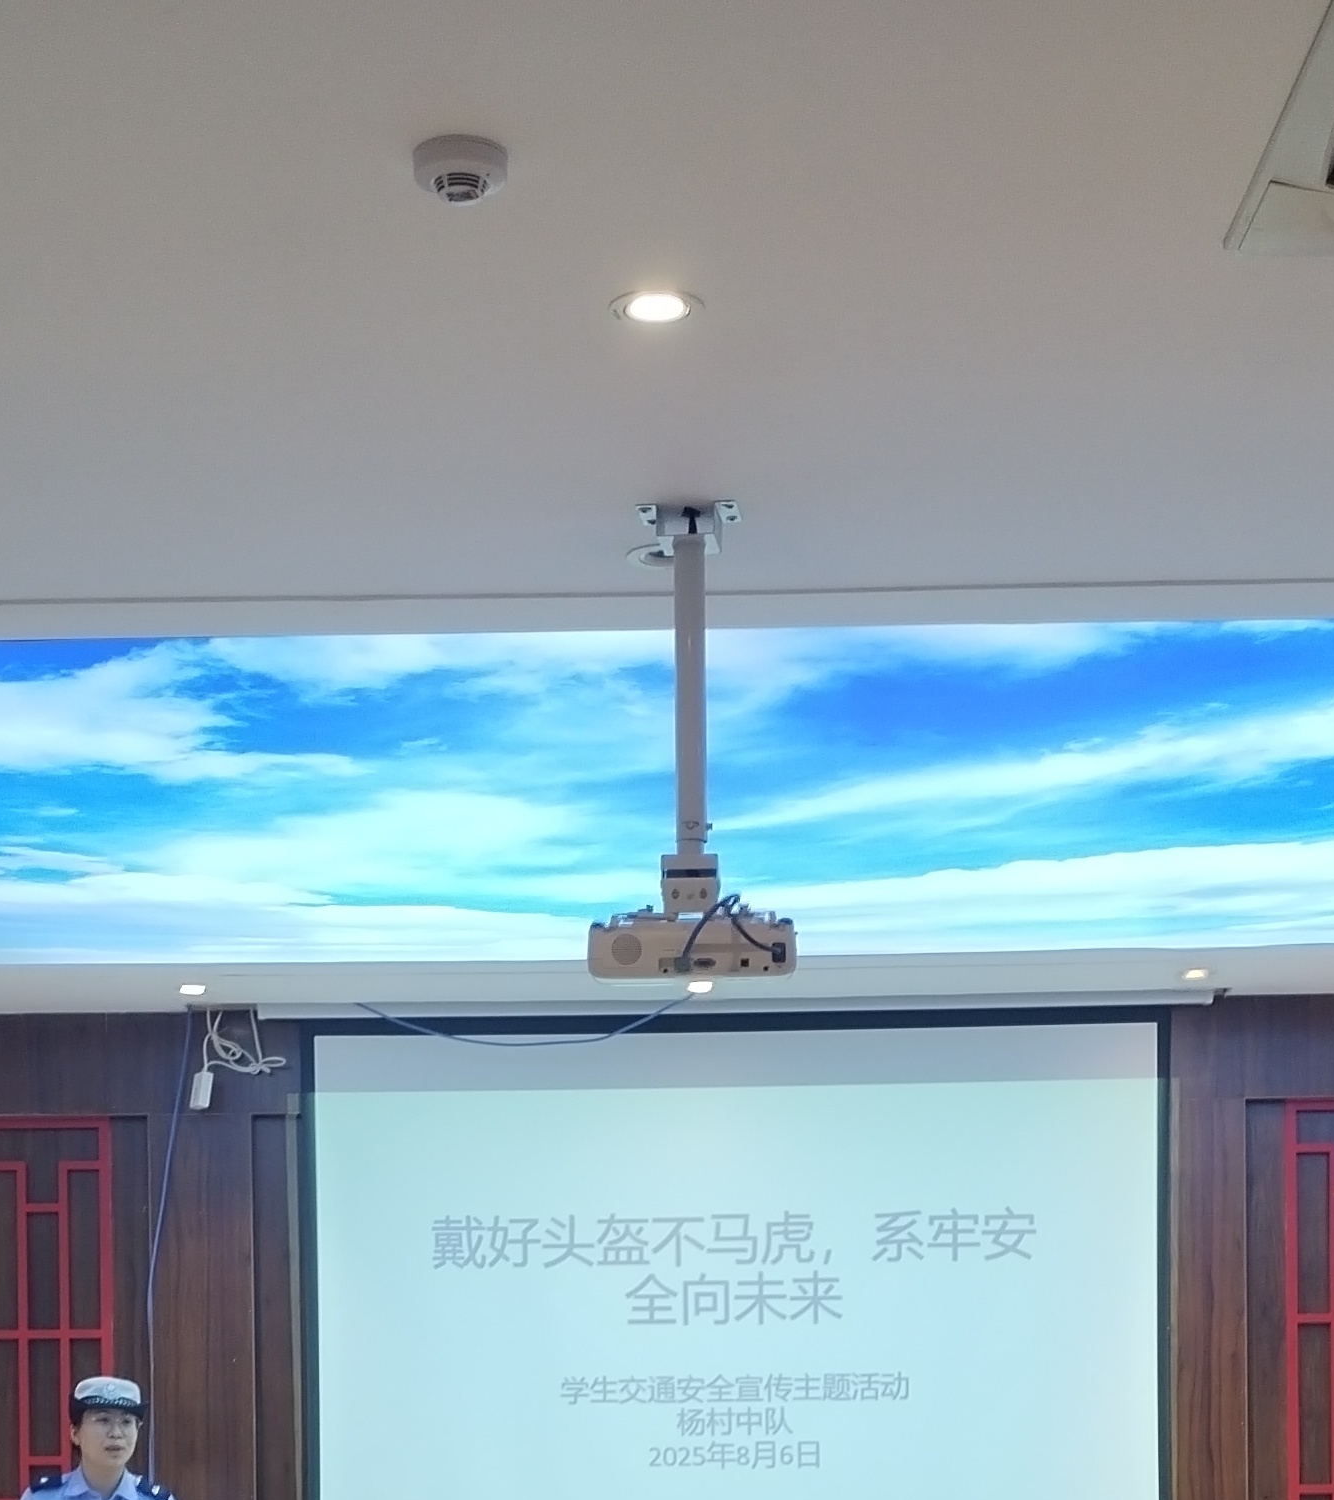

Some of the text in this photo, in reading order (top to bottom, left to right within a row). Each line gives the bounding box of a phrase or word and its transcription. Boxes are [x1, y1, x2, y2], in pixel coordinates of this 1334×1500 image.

[430, 1208, 1037, 1271] 戴好头盔不马虎，系牢安
[624, 1272, 844, 1327] 全向未来
[559, 1371, 910, 1405] 学生交通安全宣传主题活动
[676, 1408, 794, 1437] 杨村中队
[647, 1440, 822, 1472] 2025年8月6日
